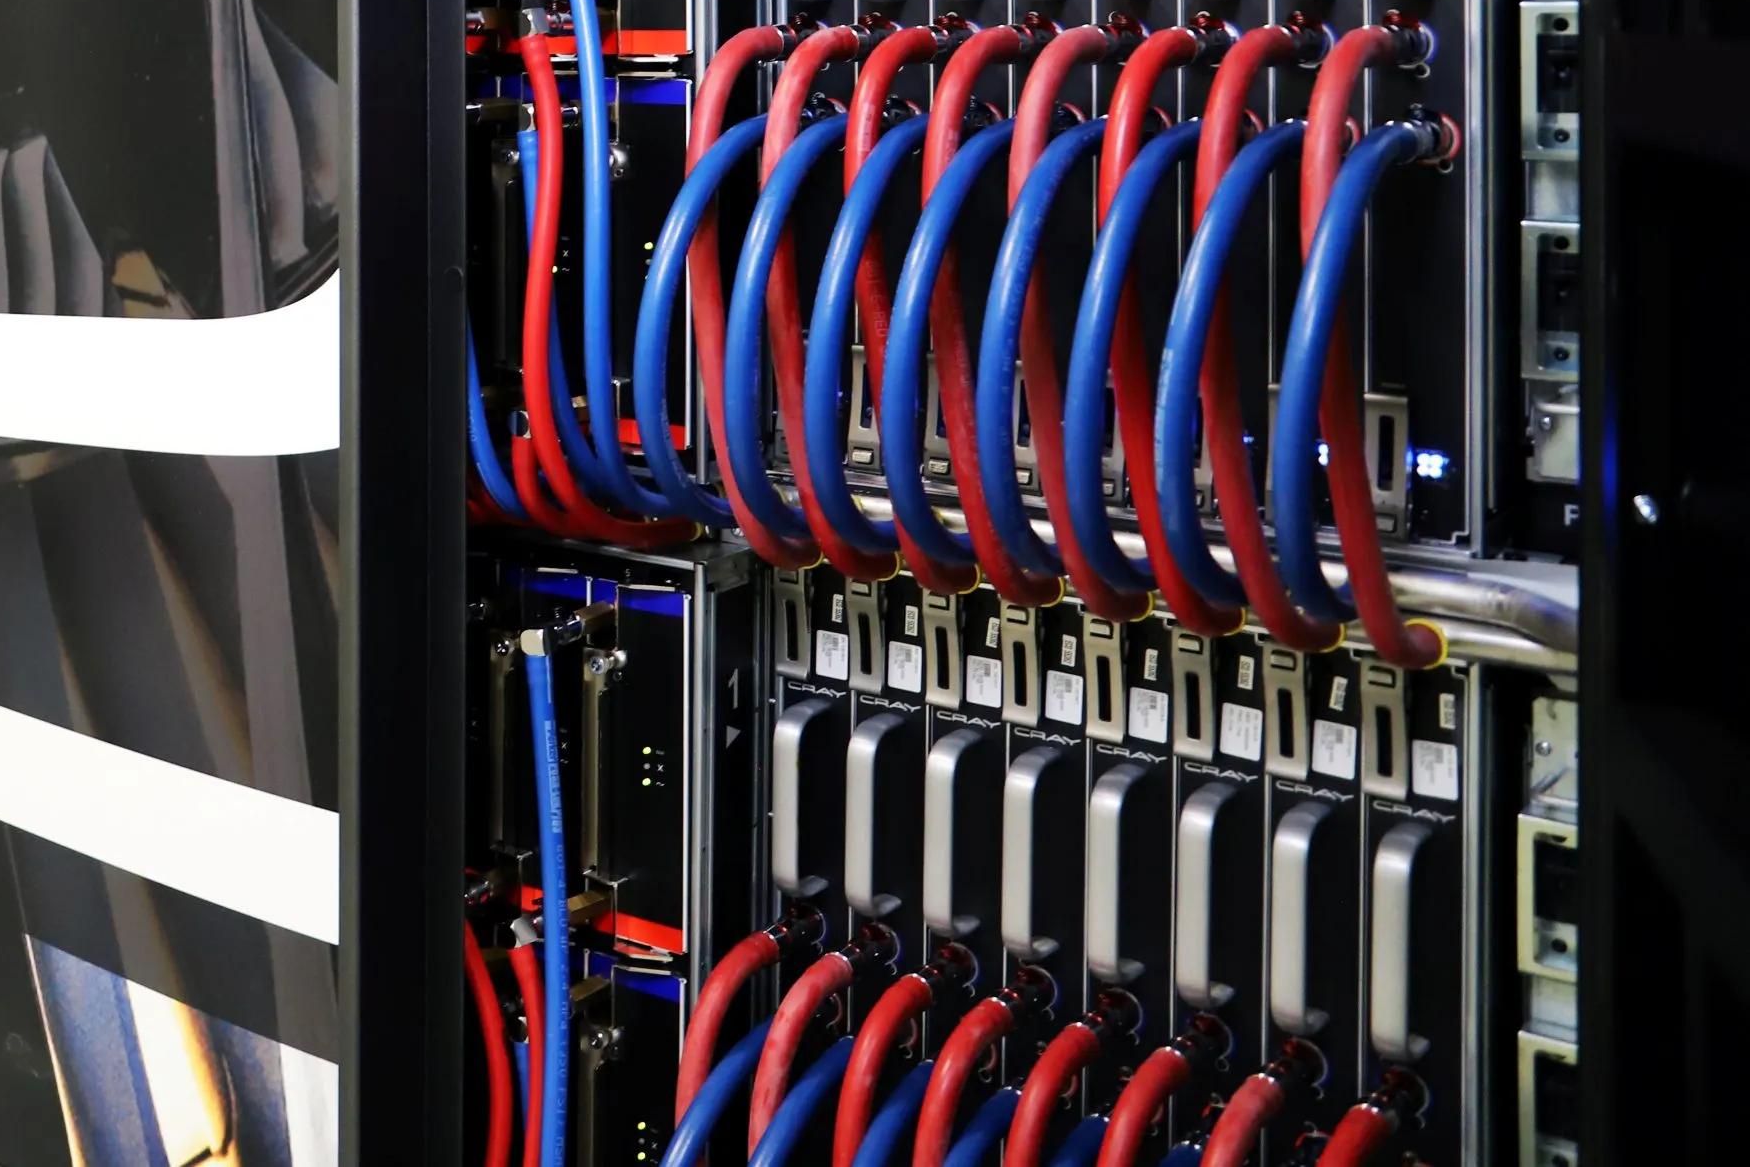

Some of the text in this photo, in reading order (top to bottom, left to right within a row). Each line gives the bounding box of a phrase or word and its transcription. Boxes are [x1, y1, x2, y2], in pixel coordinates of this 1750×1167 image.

[727, 668, 739, 709] 1
[788, 681, 846, 699] CRAY
[860, 695, 921, 713] CRAY
[937, 711, 1001, 730] CRAY
[1014, 727, 1081, 746] CRAY
[1096, 744, 1167, 764] CRAY
[1184, 762, 1258, 783] CRAY
[1275, 780, 1353, 803] CRAY
[1373, 800, 1456, 823] CRAY
